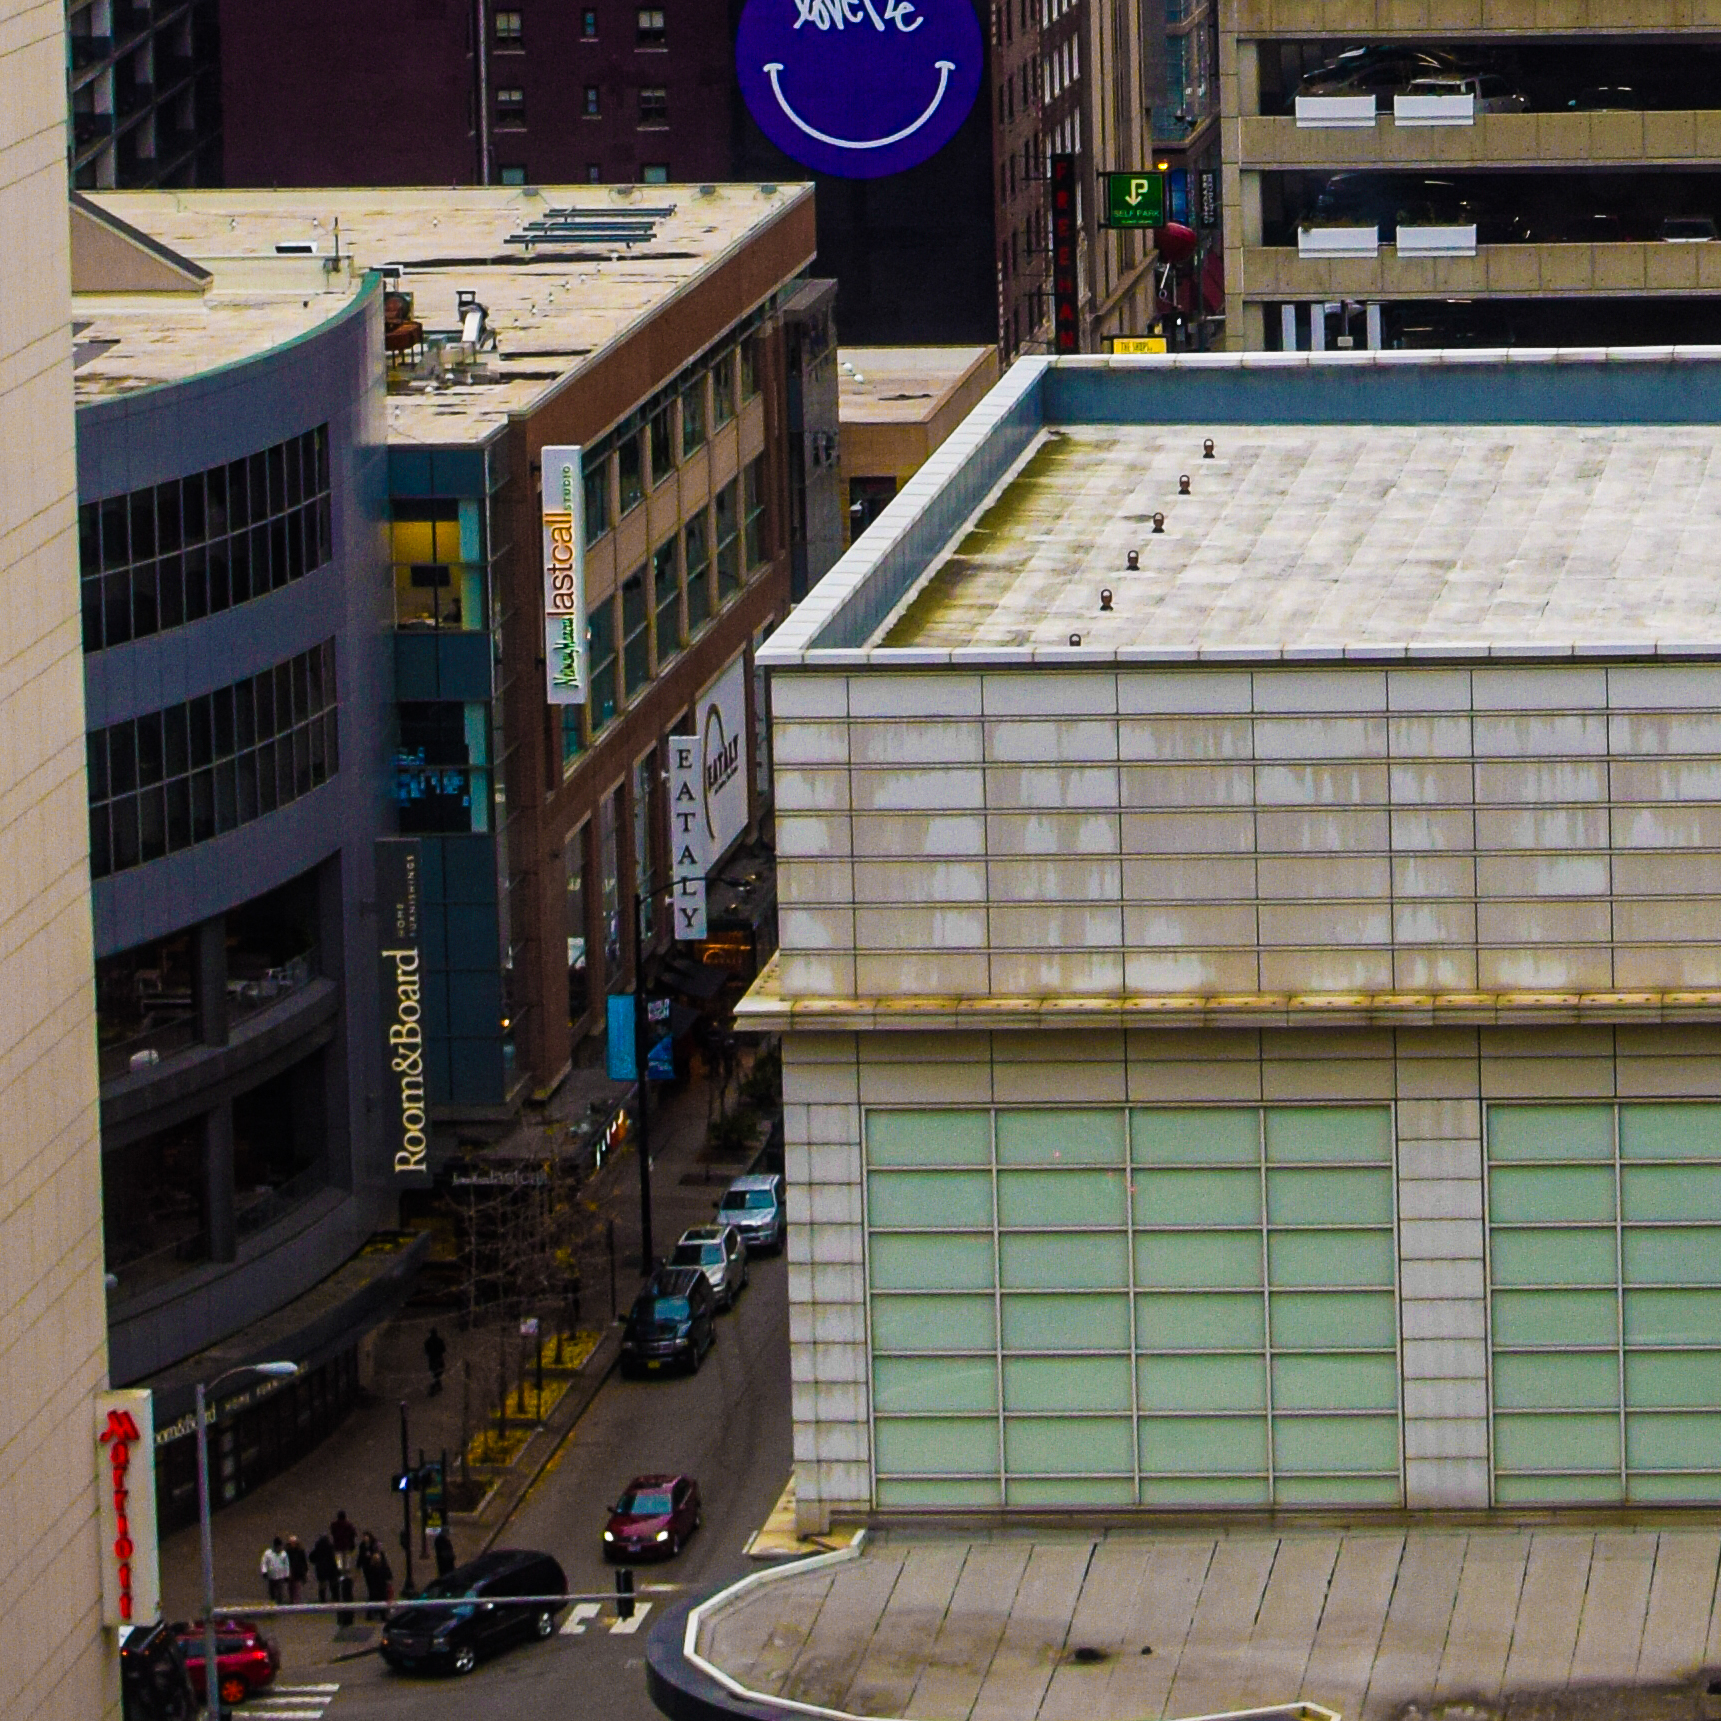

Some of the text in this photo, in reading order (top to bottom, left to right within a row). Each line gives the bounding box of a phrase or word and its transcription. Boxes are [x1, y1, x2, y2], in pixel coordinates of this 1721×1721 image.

[1113, 209, 1160, 218] SELF PARK
[562, 465, 573, 510] STUDIO
[676, 748, 699, 928] EATALY
[381, 946, 428, 1174] Room&Board
[99, 1409, 140, 1621] Marriott
